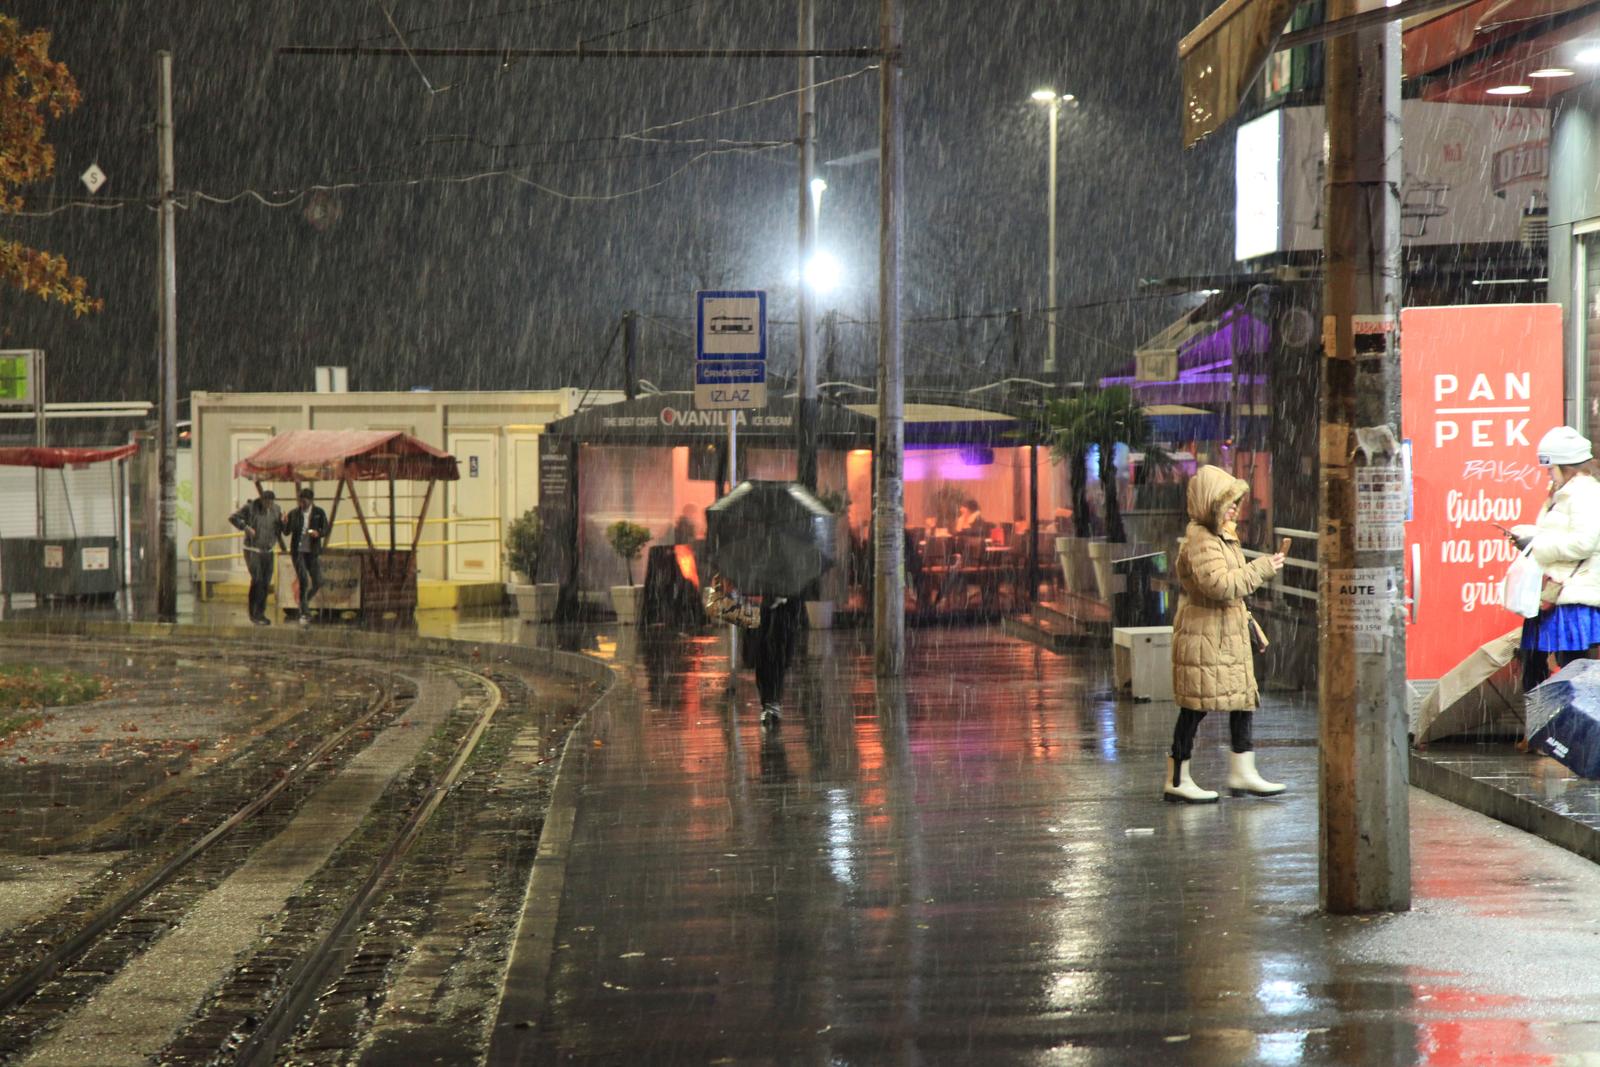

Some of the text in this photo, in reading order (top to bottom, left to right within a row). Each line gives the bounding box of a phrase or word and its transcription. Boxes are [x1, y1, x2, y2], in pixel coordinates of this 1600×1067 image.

[90, 172, 98, 184] S
[711, 389, 751, 402] IZLAZ
[1434, 372, 1530, 402] PAN
[618, 417, 634, 426] BEST
[675, 410, 747, 426] VANILA
[765, 416, 792, 426] CREAM
[1435, 418, 1530, 448] PEK
[1446, 489, 1522, 528] ljubav
[1441, 539, 1475, 563] na
[1340, 585, 1375, 595] AUTE
